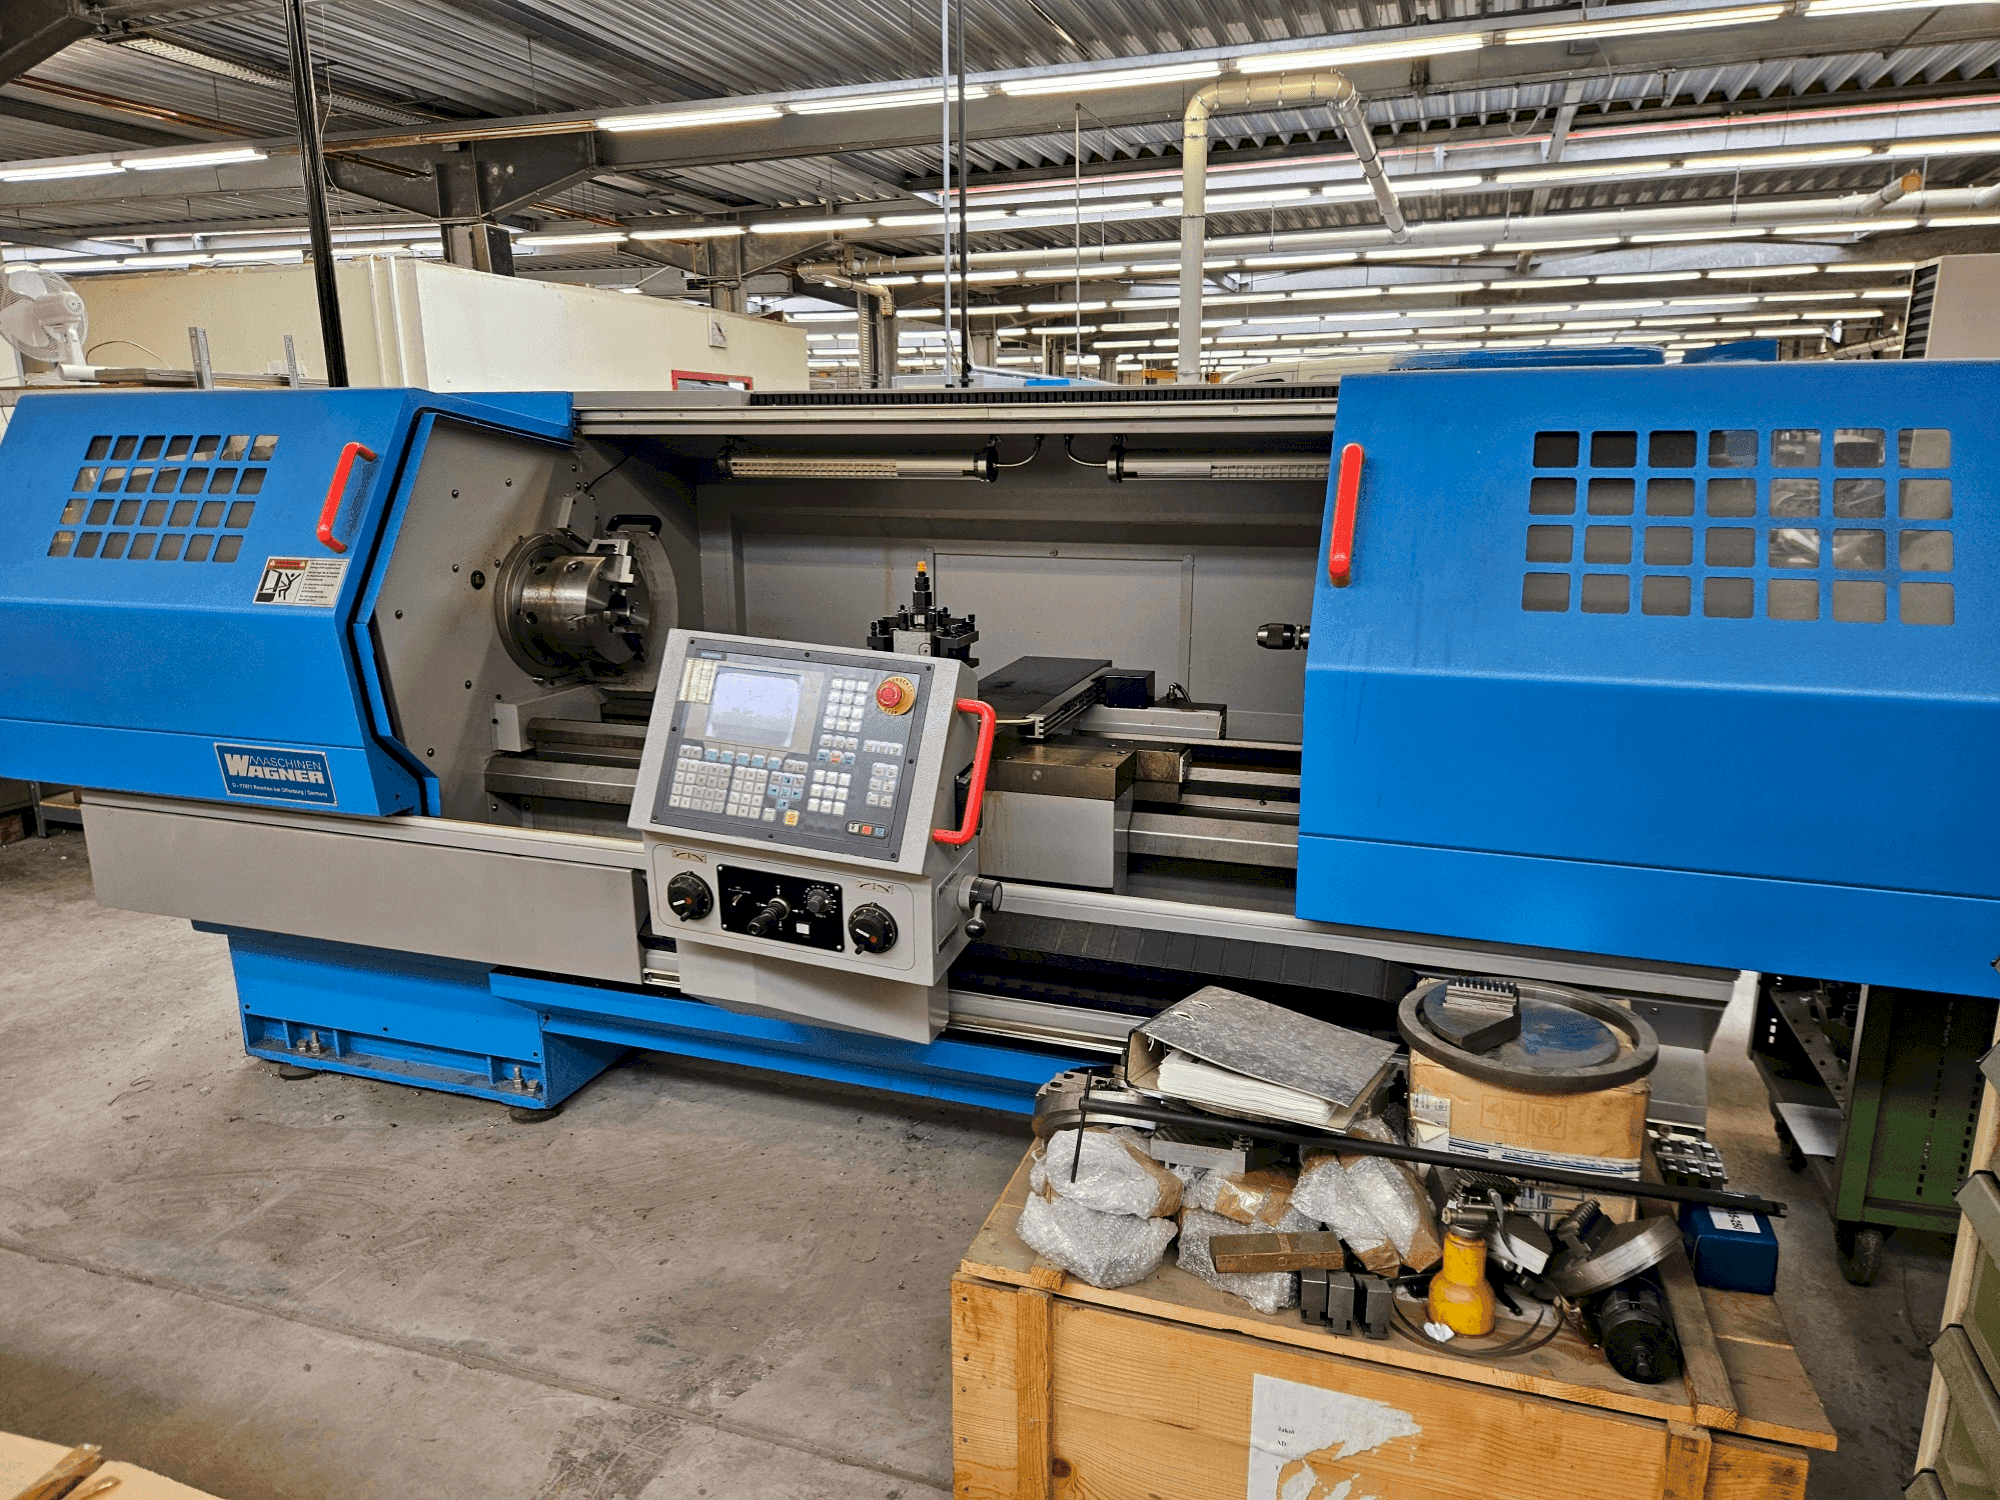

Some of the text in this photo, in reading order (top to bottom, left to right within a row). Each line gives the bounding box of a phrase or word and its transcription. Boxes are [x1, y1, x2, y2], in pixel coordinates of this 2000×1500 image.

[224, 753, 325, 784] WAGNER
[249, 756, 322, 771] MASCHINEN
[307, 790, 328, 798] Germany
